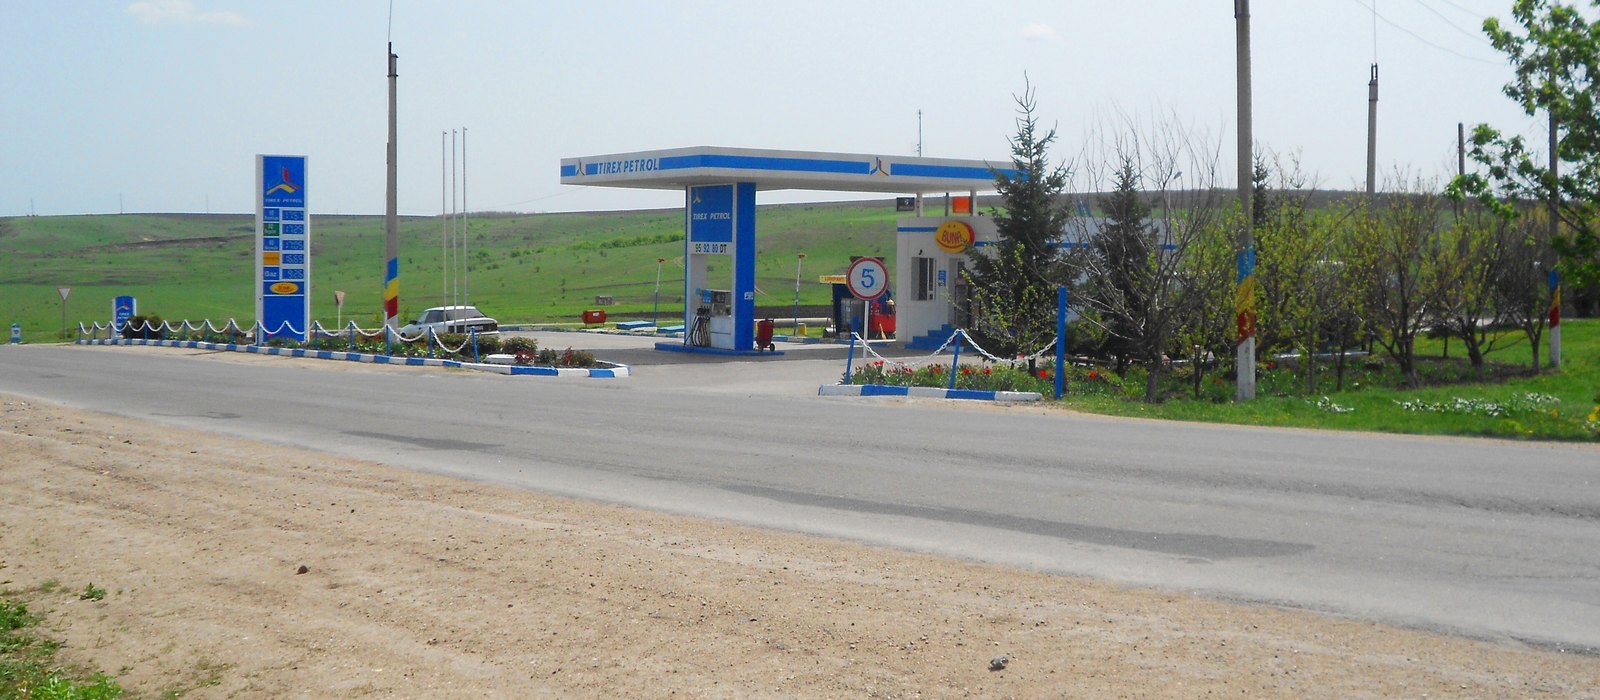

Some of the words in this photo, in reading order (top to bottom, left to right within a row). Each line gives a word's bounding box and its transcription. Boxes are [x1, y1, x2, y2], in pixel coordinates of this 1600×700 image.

[598, 161, 622, 174] TIREX
[623, 159, 658, 172] PETROL
[693, 212, 708, 220] TIREX
[709, 212, 731, 220] PETROL
[695, 243, 702, 253] 95
[703, 243, 710, 253] 92
[712, 243, 719, 253] 80
[720, 243, 727, 253] DT
[860, 268, 876, 289] 5
